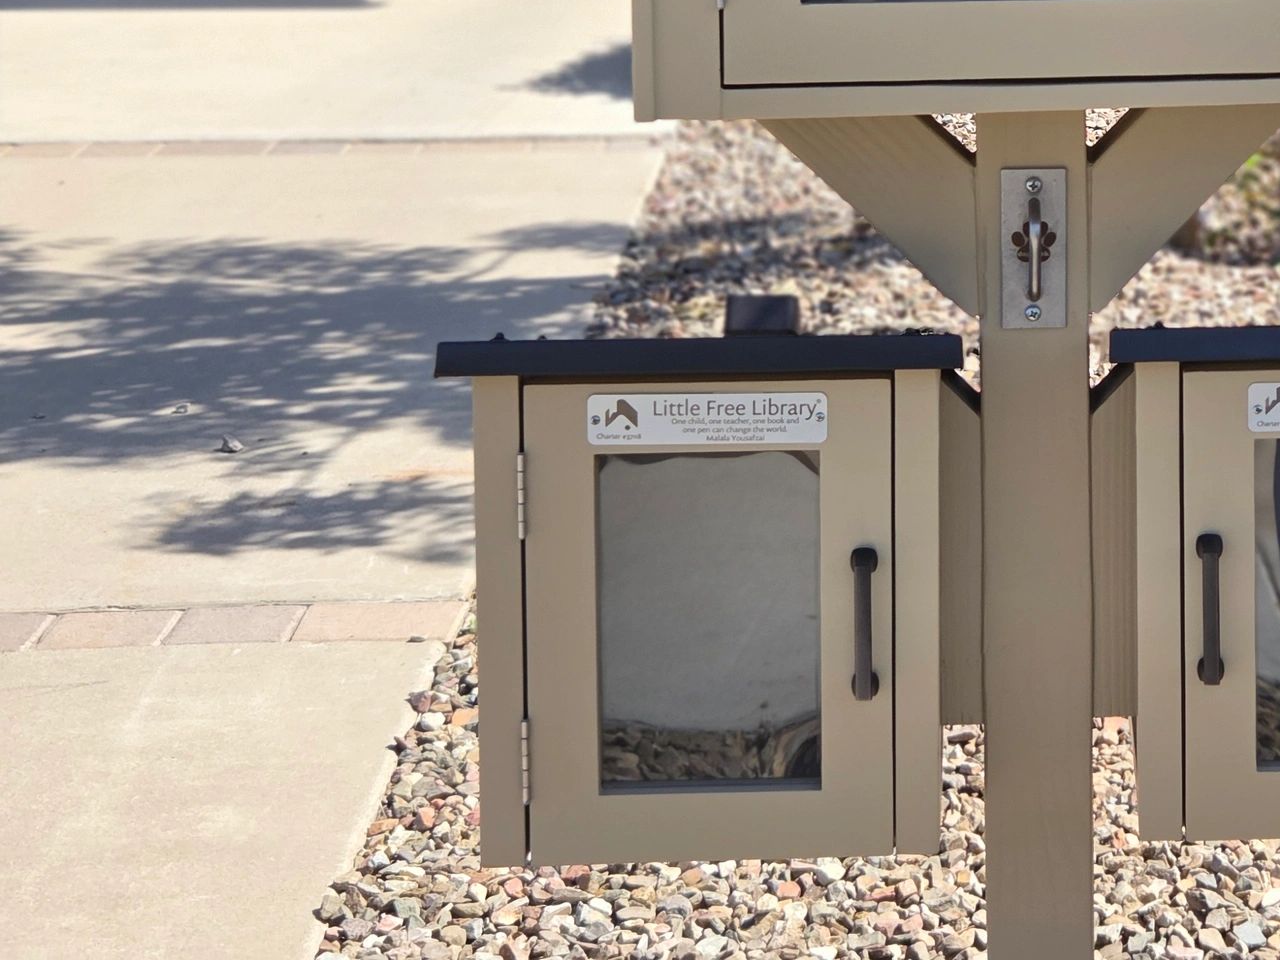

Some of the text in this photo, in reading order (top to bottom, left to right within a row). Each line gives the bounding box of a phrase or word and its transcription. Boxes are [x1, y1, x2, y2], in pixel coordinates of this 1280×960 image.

[653, 397, 817, 421] Little Free Library
[688, 417, 708, 426] child,
[723, 418, 752, 426] teacher,
[726, 426, 751, 434] change
